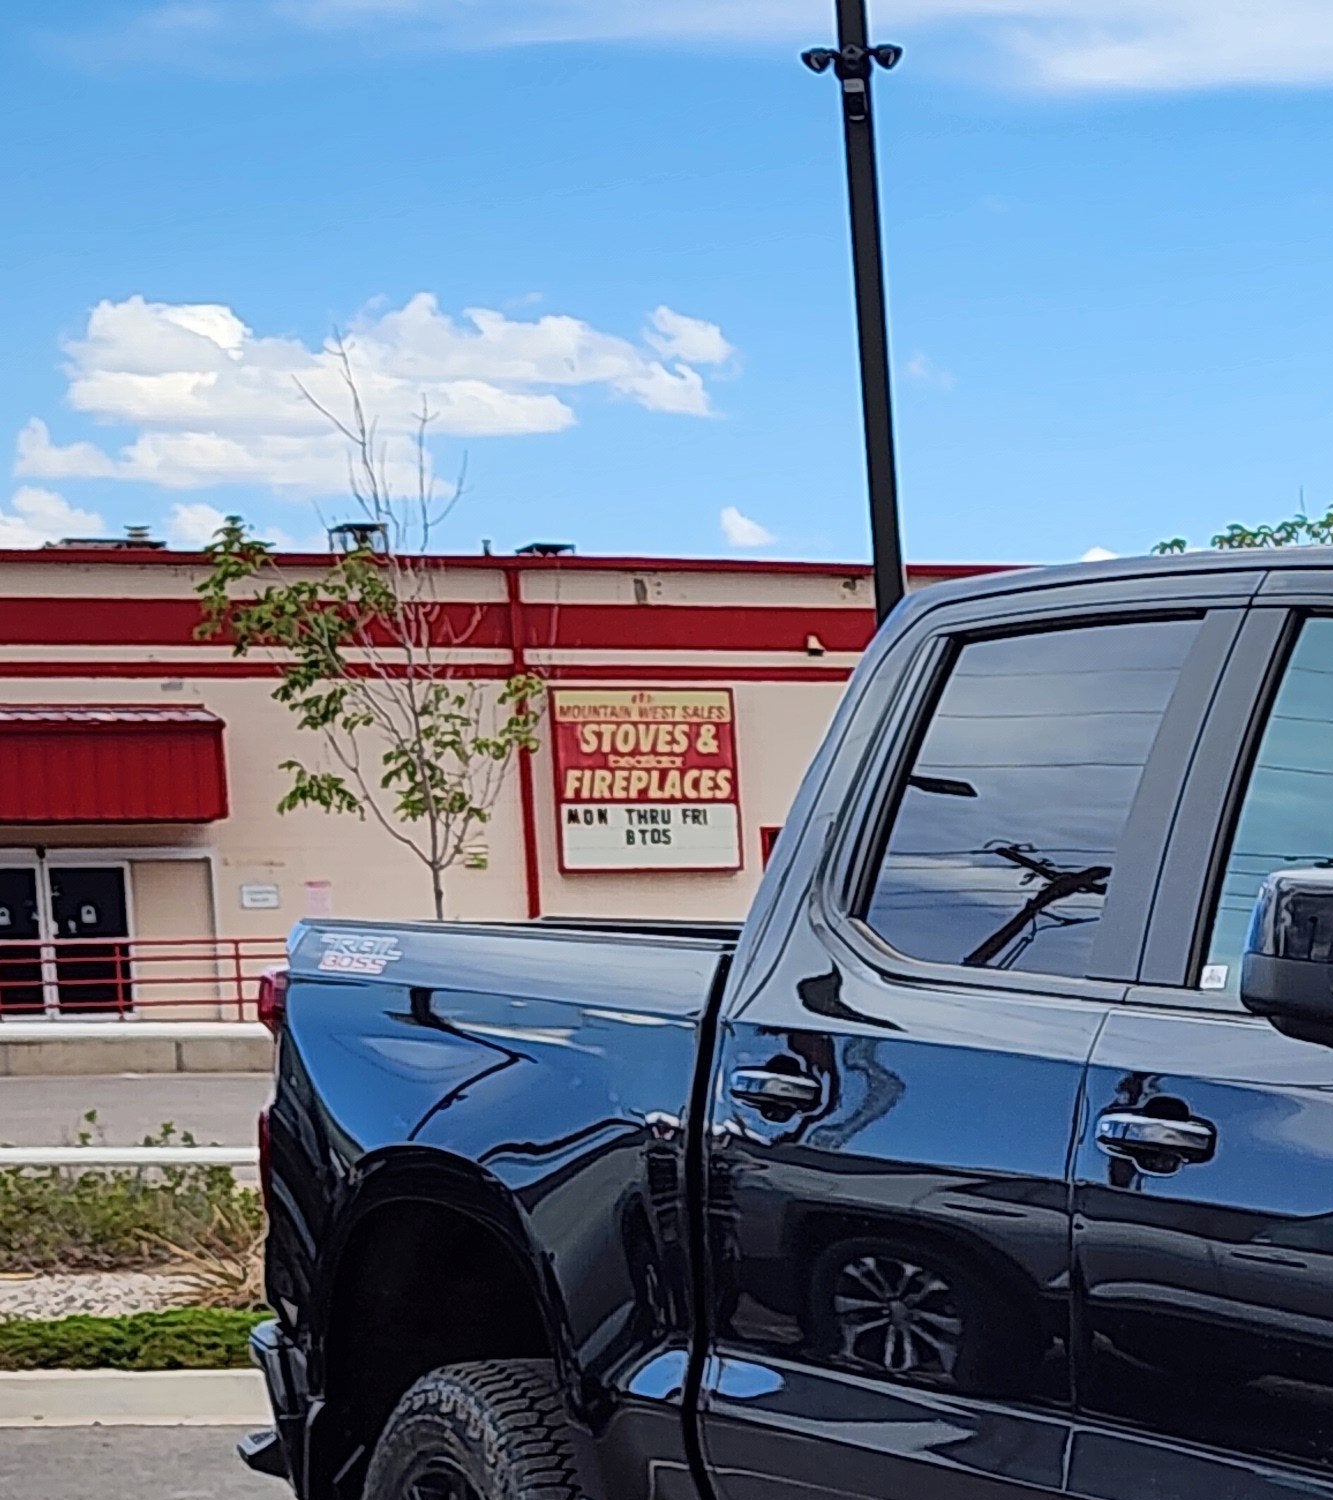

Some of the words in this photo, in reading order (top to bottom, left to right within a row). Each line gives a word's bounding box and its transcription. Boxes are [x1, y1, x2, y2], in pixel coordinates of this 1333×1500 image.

[559, 704, 631, 719] MOUNTAIN
[638, 704, 676, 719] WEST
[682, 704, 726, 719] SALES
[580, 724, 689, 754] STOVES
[696, 724, 719, 754] &
[564, 769, 732, 799] FIREPLACES
[567, 808, 608, 825] MON
[625, 808, 671, 825] THRU
[682, 808, 708, 825] FRI
